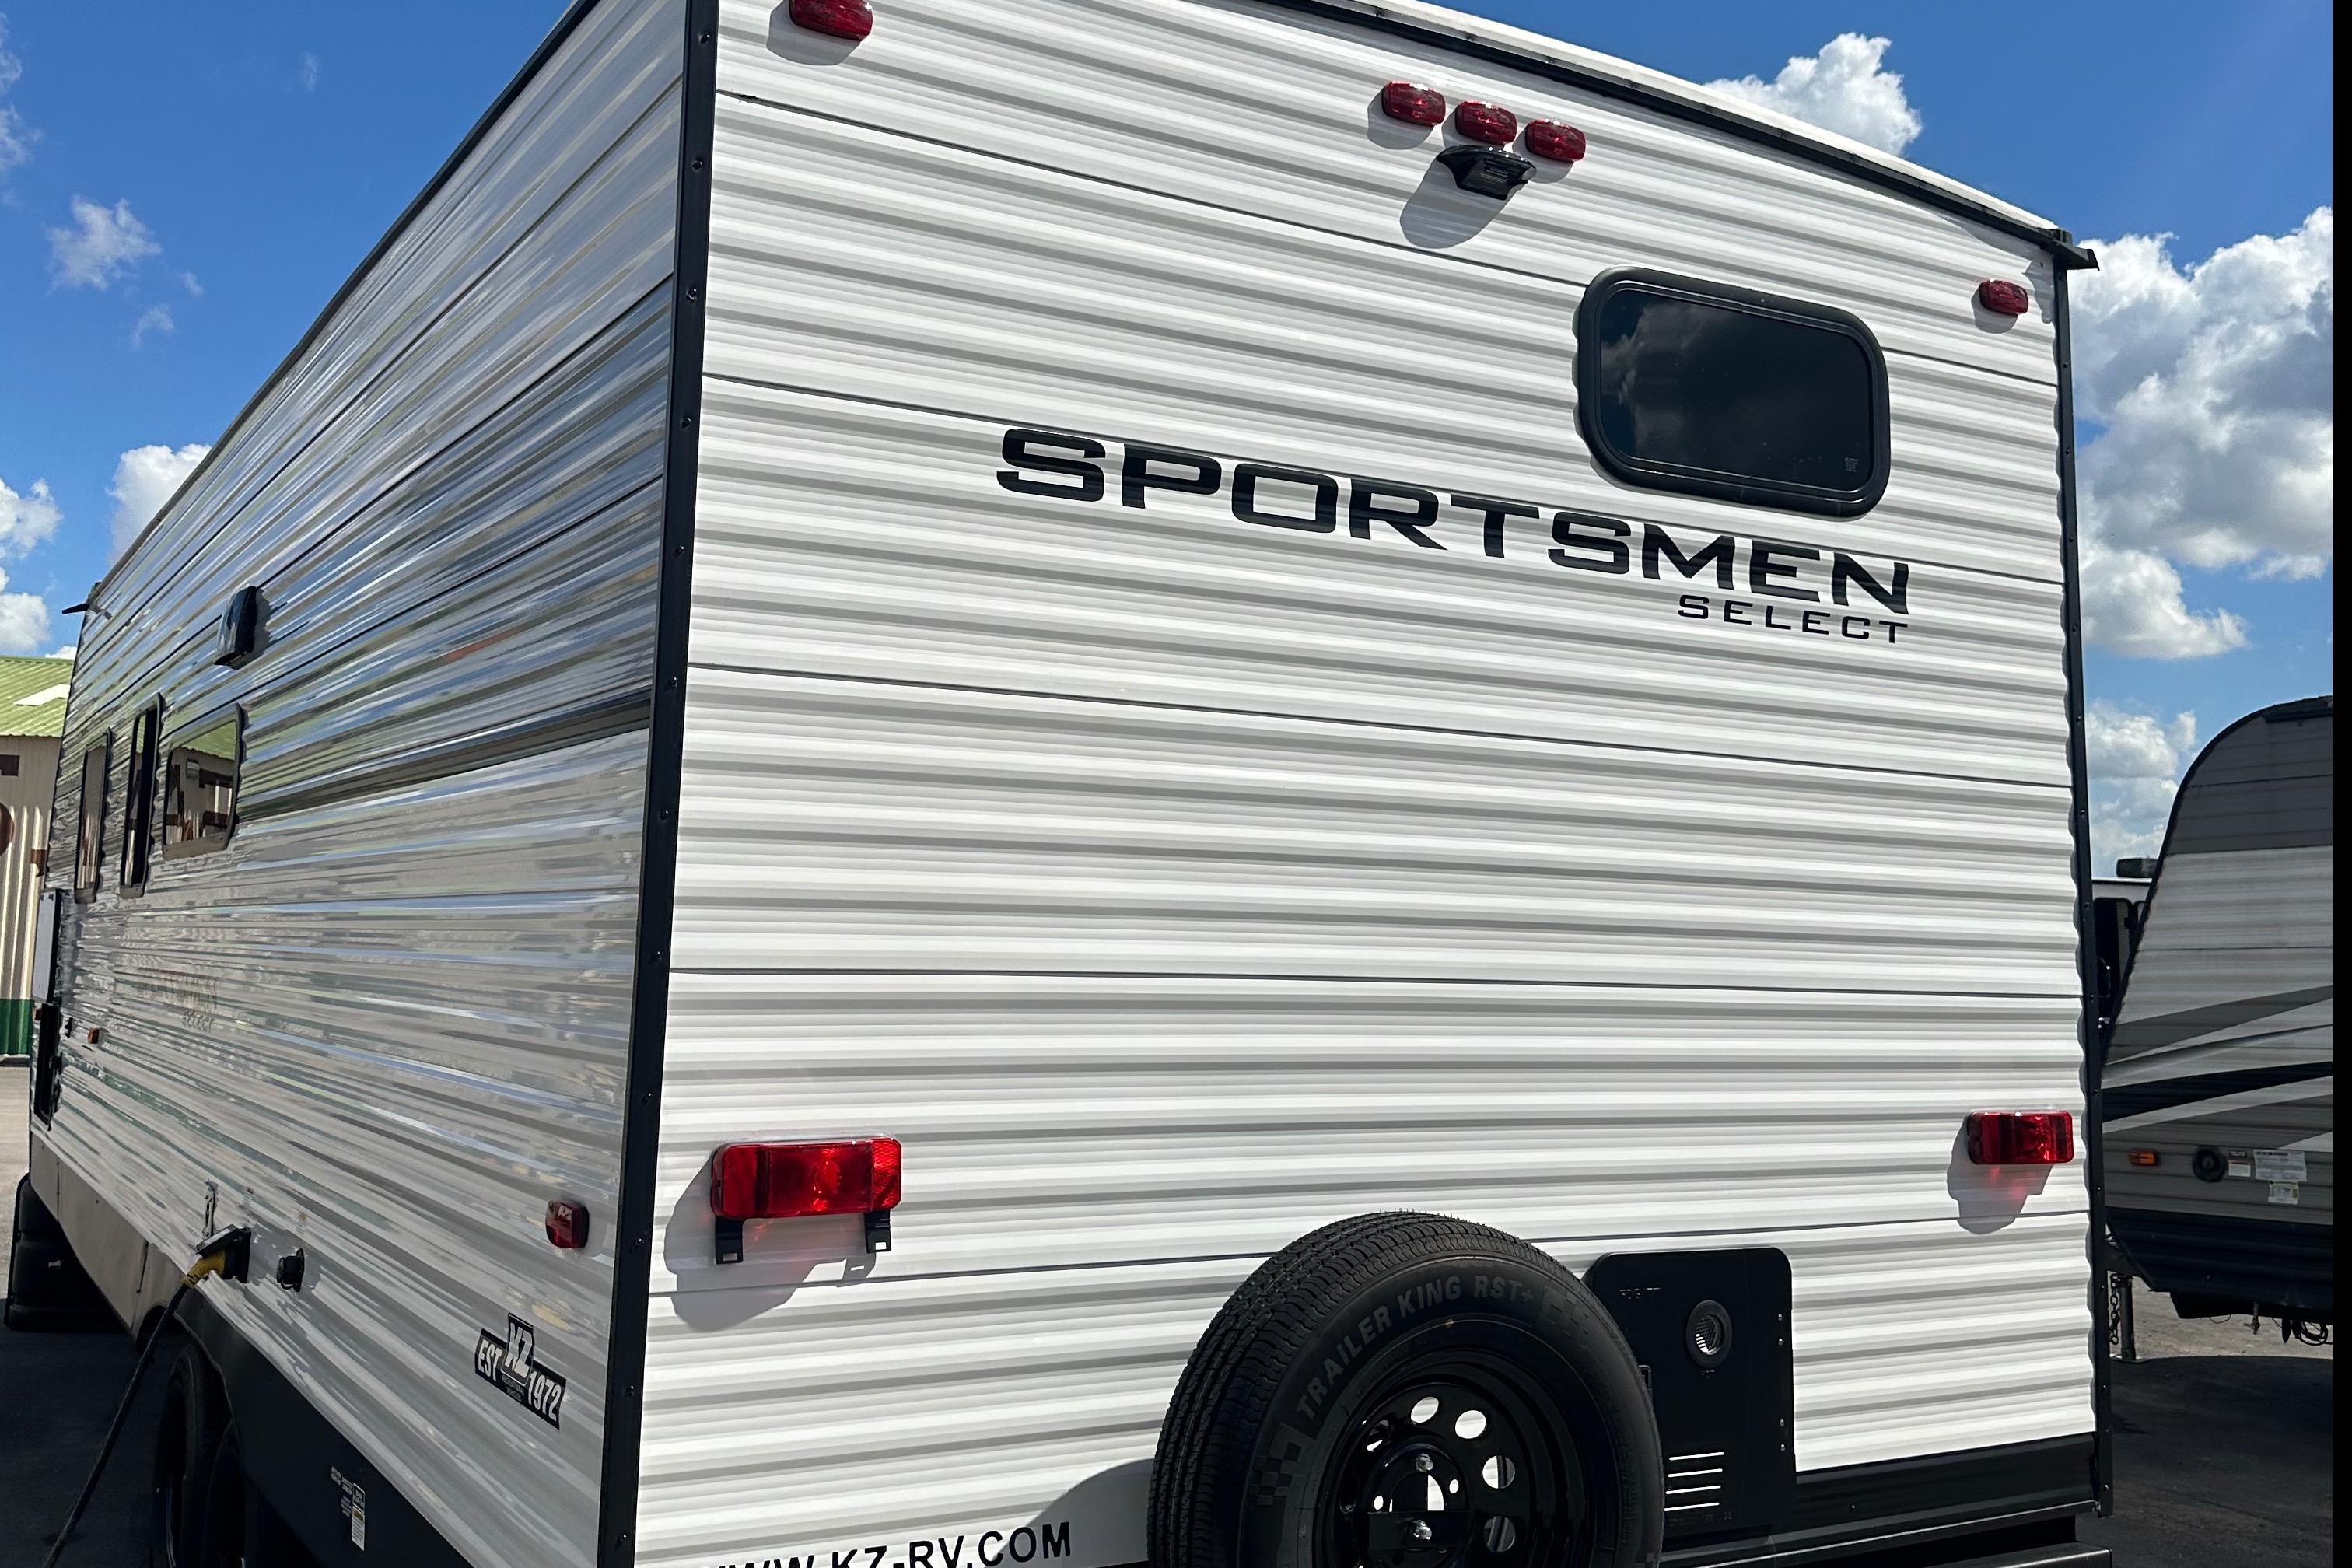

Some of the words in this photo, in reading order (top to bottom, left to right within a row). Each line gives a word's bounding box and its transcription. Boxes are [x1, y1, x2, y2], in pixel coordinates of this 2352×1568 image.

[996, 428, 1909, 615] SPORTSMEN
[1678, 594, 1908, 643] SELECT
[478, 1339, 503, 1381] EST
[528, 1370, 562, 1422] 1972
[504, 1321, 533, 1378] KZ
[1296, 1305, 1392, 1419] TRAILER
[1397, 1276, 1461, 1318] KING
[1473, 1275, 1534, 1302] RST+
